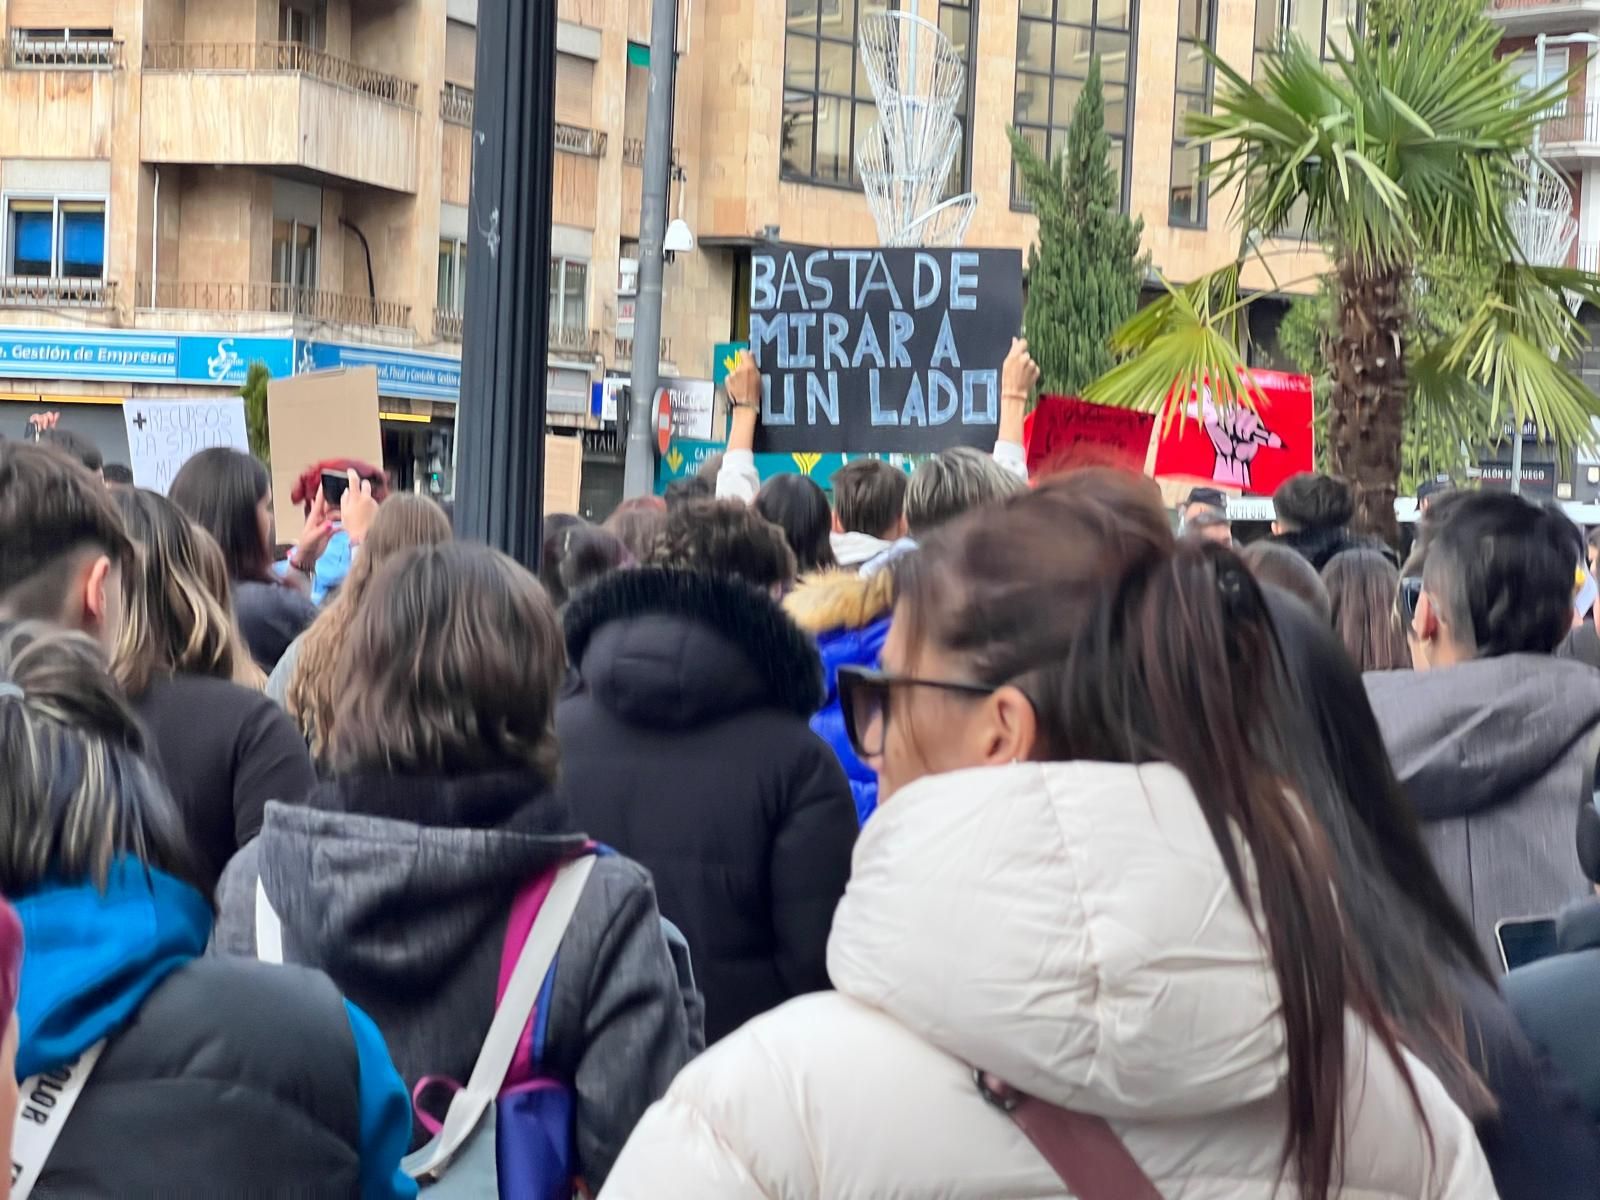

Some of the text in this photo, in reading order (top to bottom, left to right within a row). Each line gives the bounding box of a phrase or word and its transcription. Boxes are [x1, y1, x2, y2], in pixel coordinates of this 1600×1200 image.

[750, 250, 979, 310] BASTA DE
[12, 344, 70, 361] Gestión
[74, 346, 93, 361] de
[98, 347, 175, 366] Empresas
[749, 309, 961, 370] MIRAR A
[761, 371, 840, 425] UN
[869, 368, 998, 427] LADO
